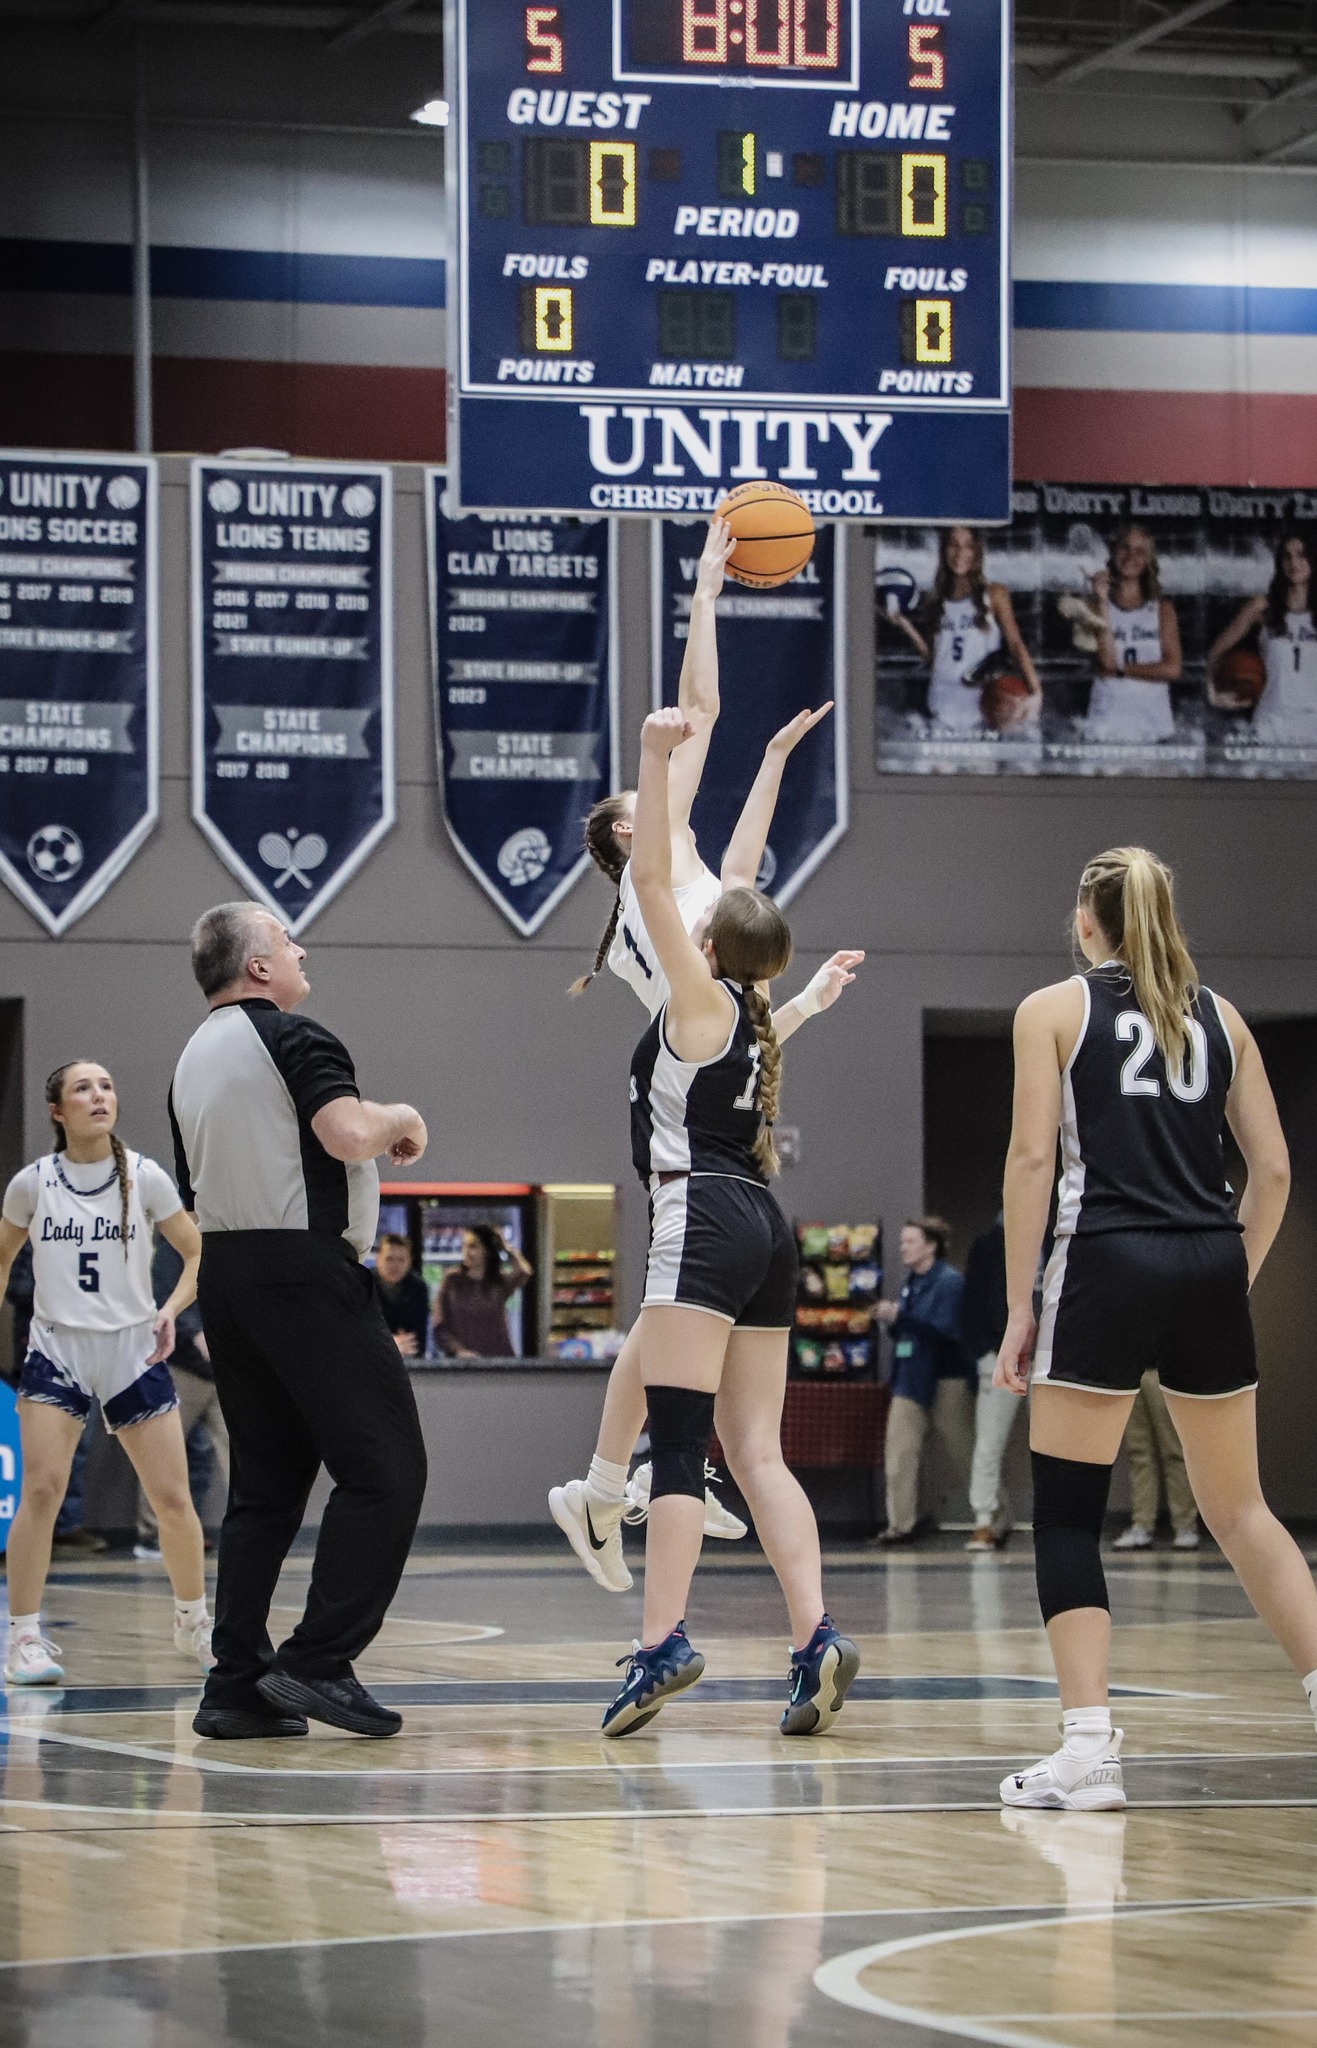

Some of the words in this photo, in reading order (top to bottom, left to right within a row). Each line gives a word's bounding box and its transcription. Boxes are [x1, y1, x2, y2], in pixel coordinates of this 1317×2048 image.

[526, 7, 563, 73] 5
[683, 0, 838, 67] 8:00
[908, 25, 944, 89] 5
[506, 88, 651, 129] GUEST
[829, 101, 956, 140] HOME
[742, 132, 755, 196] 1
[589, 141, 636, 226] 0
[901, 153, 946, 237] 0
[674, 206, 800, 239] PERIOD
[502, 253, 589, 279] FOULS
[646, 258, 829, 289] PLAYER-FOUL
[884, 266, 968, 292] FOULS
[535, 287, 573, 351] 0
[915, 299, 952, 363] 0
[499, 358, 595, 384] POINTS
[649, 363, 744, 388] MATCH
[878, 369, 973, 395] POINTS
[579, 405, 892, 482] UNITY
[10, 472, 102, 510] UNITY
[247, 482, 338, 518] UNITY
[589, 483, 726, 510] CHRISTIA
[801, 489, 884, 515] HOOL
[0, 516, 42, 541] ONS
[47, 517, 138, 546] SOCCER
[216, 523, 283, 550] LIONS
[289, 525, 371, 553] TENNIS
[492, 528, 554, 553] LIONS
[41, 559, 122, 578] CHAMPIONS
[278, 567, 358, 585] CHAMPIONS
[447, 552, 499, 576] CLAY
[507, 554, 599, 578] TARGETS
[17, 583, 53, 600] 2017
[254, 591, 289, 609] 2017
[230, 637, 271, 654] STATE
[463, 661, 503, 679] STATE
[26, 702, 84, 725] STATE
[263, 709, 320, 731] STATE
[0, 724, 111, 749] CHAMPIONS
[236, 731, 347, 755] CHAMPIONS
[497, 733, 552, 755] STATE
[216, 761, 249, 778] 2017
[470, 756, 579, 779] CHAMPIONS
[1115, 1010, 1209, 1103] 20
[41, 1216, 83, 1247] Lady
[91, 1216, 136, 1241] Lios
[78, 1252, 99, 1293] 5
